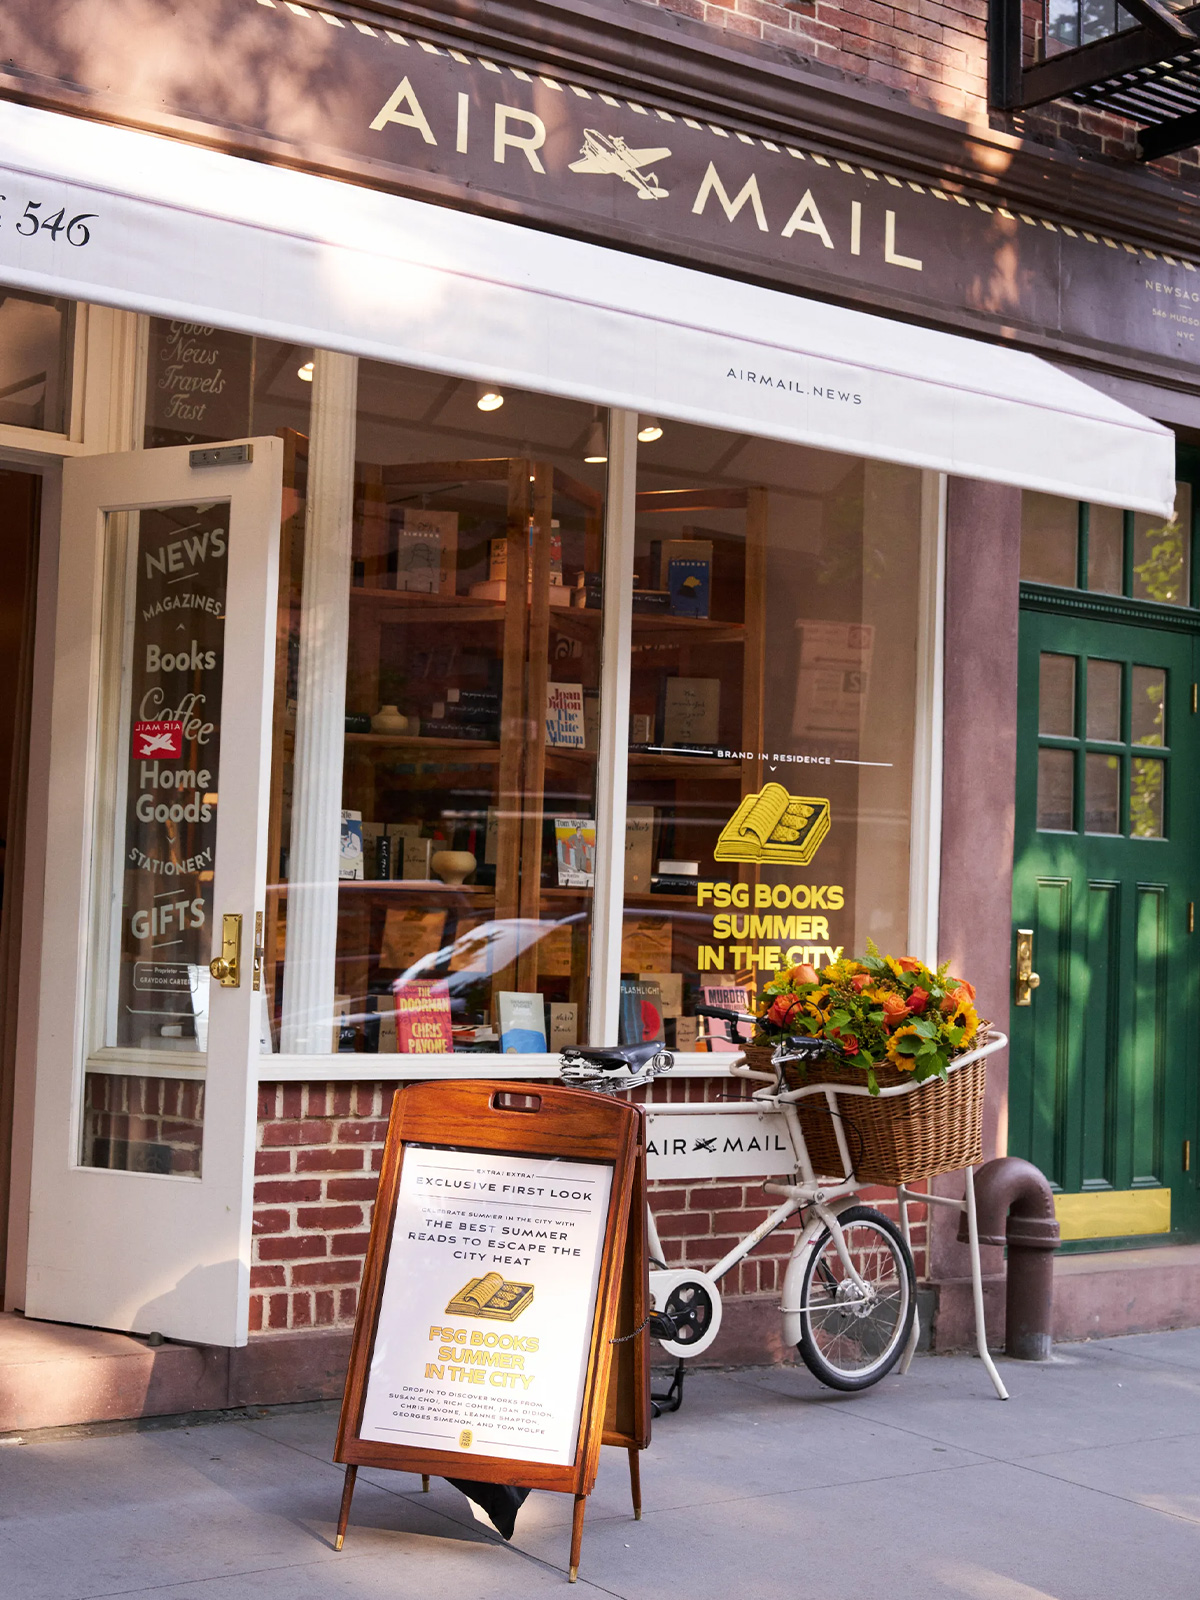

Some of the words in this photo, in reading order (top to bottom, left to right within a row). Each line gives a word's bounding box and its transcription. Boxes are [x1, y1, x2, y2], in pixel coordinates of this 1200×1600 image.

[369, 76, 546, 174] AIR
[692, 161, 922, 271] MAIL
[16, 201, 99, 247] 546
[1145, 280, 1200, 302] NEWSAG
[1170, 312, 1200, 326] HUDSO
[1176, 330, 1195, 341] NYC
[160, 337, 219, 365] News
[158, 365, 226, 394] Travels
[727, 368, 862, 405] AIRMAIL.NEWS
[164, 394, 207, 421] Fast
[145, 528, 226, 579] NEWS
[143, 594, 222, 621] MAGAZINES
[146, 640, 216, 672] Books
[139, 687, 214, 744] Coffee
[717, 750, 754, 760] BRAND
[773, 754, 831, 765] RESIDENCE
[140, 761, 212, 789] Home
[136, 792, 212, 823] Goods
[129, 847, 212, 876] STATIONERY
[697, 882, 750, 909] FSG
[755, 883, 845, 911] BOOKS
[131, 898, 205, 939] GIFTS
[713, 913, 830, 941] SUMMER
[697, 945, 725, 971] IN
[729, 945, 781, 971] THE
[785, 945, 844, 970] CITY
[418, 986, 431, 997] THE
[621, 985, 660, 996] FLASHLIGHT
[708, 989, 746, 1004] MURDER
[400, 998, 449, 1012] DOORMAN
[411, 1022, 443, 1038] CHRIS
[408, 1038, 448, 1054] PAVONE
[646, 1139, 687, 1155] AIR
[723, 1135, 786, 1153] MAIL
[416, 1177, 496, 1192] EXCLUSIVE
[502, 1185, 545, 1196] FIRST
[550, 1190, 591, 1201] LOOK
[468, 1212, 503, 1220] SUMMER
[425, 1219, 453, 1229] THE
[459, 1222, 496, 1233] BEST
[501, 1226, 568, 1241] SUMMER
[408, 1232, 457, 1244] READS
[462, 1237, 482, 1246] TO
[488, 1240, 546, 1253] ESCAPE
[552, 1246, 581, 1257] THE
[453, 1250, 487, 1261] CITY
[493, 1255, 531, 1266] HEAT
[429, 1325, 468, 1345] FSG
[470, 1330, 539, 1353] BOOKS
[438, 1346, 525, 1370] SUMMER
[424, 1363, 445, 1380] IN
[448, 1365, 486, 1385] THE
[489, 1371, 535, 1390] CITY
[388, 1393, 416, 1401] SUSAN
[448, 1392, 488, 1401] DISCOVER
[490, 1397, 517, 1405] WORKS
[392, 1411, 431, 1420] GEORGES
[497, 1423, 515, 1431] TOM
[517, 1426, 545, 1434] WOLFE
[400, 1403, 425, 1411] CHRIS
[464, 1411, 496, 1420] LEANNE
